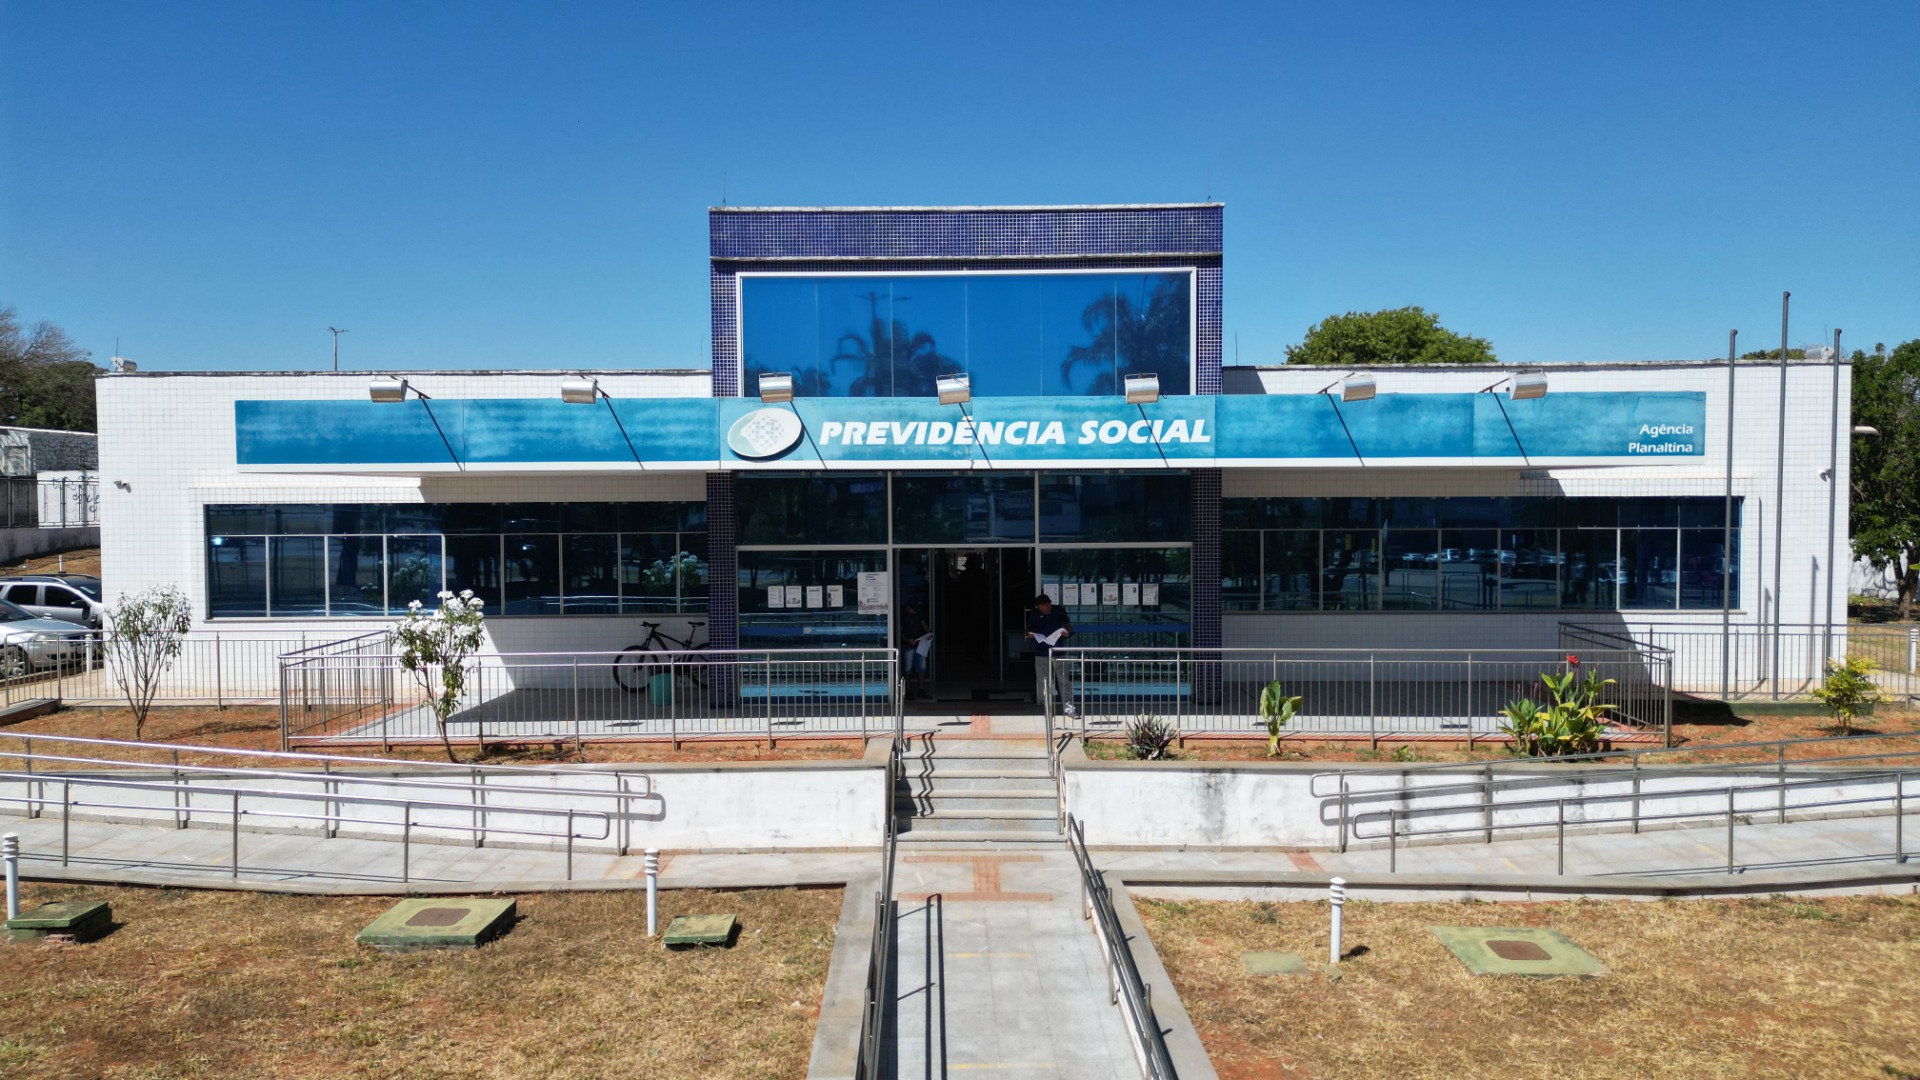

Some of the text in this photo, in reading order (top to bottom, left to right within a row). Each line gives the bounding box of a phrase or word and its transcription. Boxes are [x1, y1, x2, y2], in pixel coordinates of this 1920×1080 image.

[819, 416, 1212, 445] PREVIDÊNCIA SOCIAL
[1639, 424, 1693, 438] Agência
[1628, 442, 1693, 453] Planaltina
